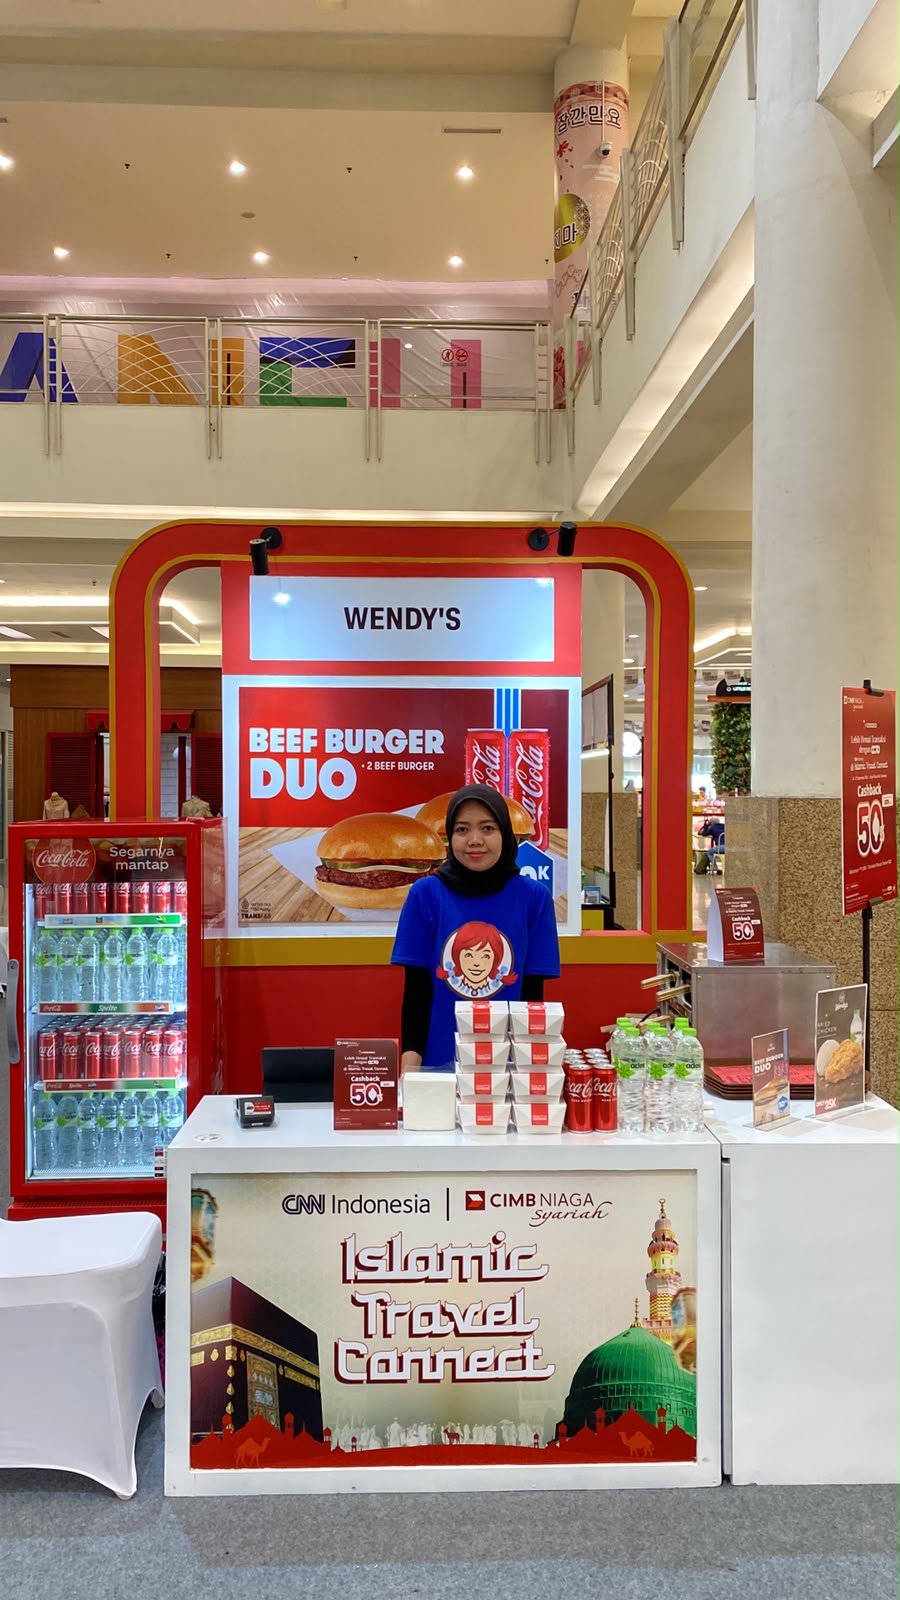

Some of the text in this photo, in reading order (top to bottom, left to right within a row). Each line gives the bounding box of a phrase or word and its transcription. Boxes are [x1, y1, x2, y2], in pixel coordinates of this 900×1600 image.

[344, 607, 461, 630] WENDY'S
[249, 727, 445, 754] BEEF BURGER
[367, 761, 435, 771] 2 BEEF BURGER
[250, 757, 358, 800] DUO
[857, 783, 882, 798] Cashback
[36, 850, 90, 868] Coca-Cola
[109, 846, 175, 860] Segarnya
[115, 860, 169, 872] mantap
[754, 1062, 771, 1074] DUO
[281, 1193, 594, 1215] CNN Indonesia CIMB NIAGA
[340, 1230, 550, 1284] Islamic
[350, 1287, 541, 1338] Travel
[333, 1334, 556, 1384] Connect
